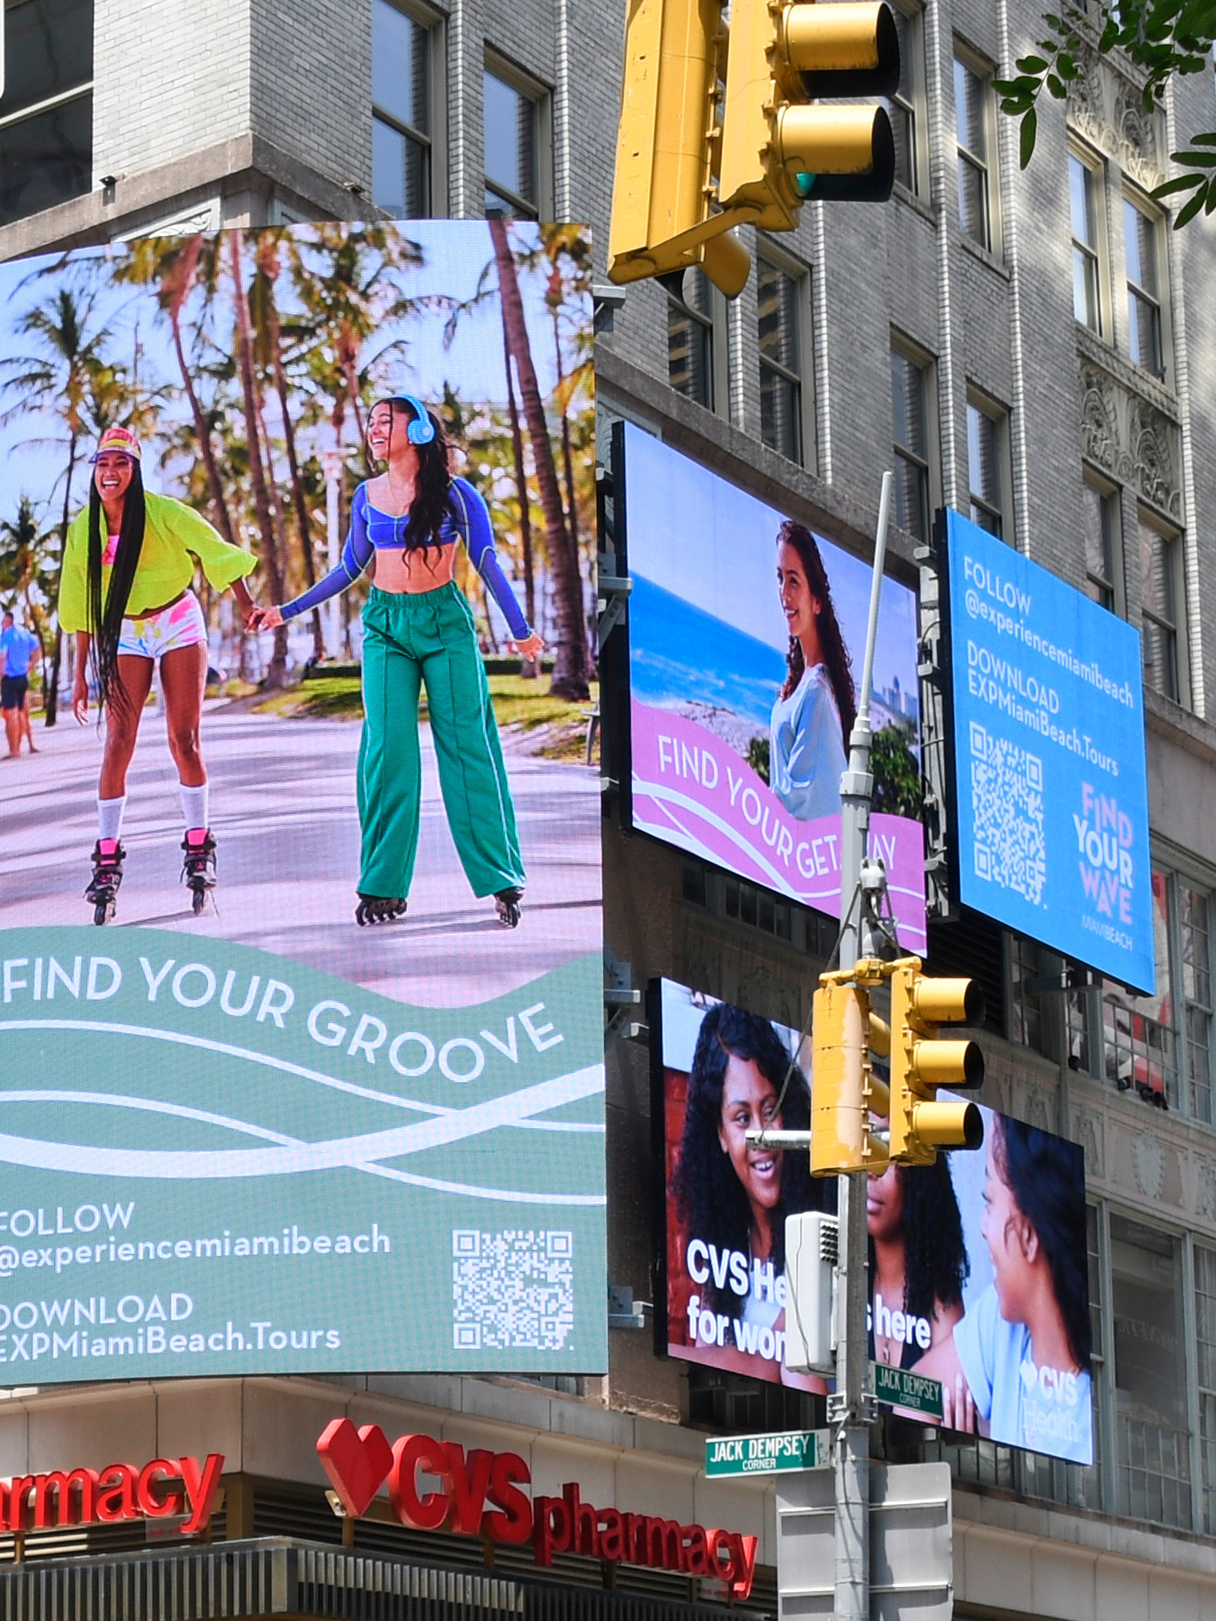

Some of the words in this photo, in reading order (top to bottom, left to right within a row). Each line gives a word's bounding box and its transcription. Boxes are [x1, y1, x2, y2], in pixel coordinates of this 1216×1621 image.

[964, 555, 1031, 617] FOLLOW
[965, 589, 1134, 709] @experiencemiamibeach
[967, 640, 1060, 715] DOWNLOAD
[968, 669, 1119, 777] EXPMiamiBeach.Tours
[658, 734, 719, 790] FIND
[726, 766, 794, 867] YOUR
[796, 834, 896, 879] GETAY
[1082, 780, 1133, 848] FIND
[1072, 813, 1133, 889] YOUR
[1079, 861, 1133, 925] WAVE
[3, 956, 122, 1004] FIND
[138, 956, 295, 1029] YOUR
[307, 1001, 565, 1083] GROOVE
[686, 1238, 749, 1296] CVS
[687, 1294, 729, 1347] for
[875, 1293, 931, 1350] here
[878, 1368, 900, 1391] JACK
[904, 1374, 940, 1402] DEMPSEY
[1039, 1365, 1078, 1407] CVS
[710, 1441, 743, 1462] JACK
[749, 1435, 809, 1458] DEMPSEY
[742, 1458, 776, 1471] CORNER
[388, 1434, 532, 1544] CVS
[533, 1482, 757, 1600] pharmacy
